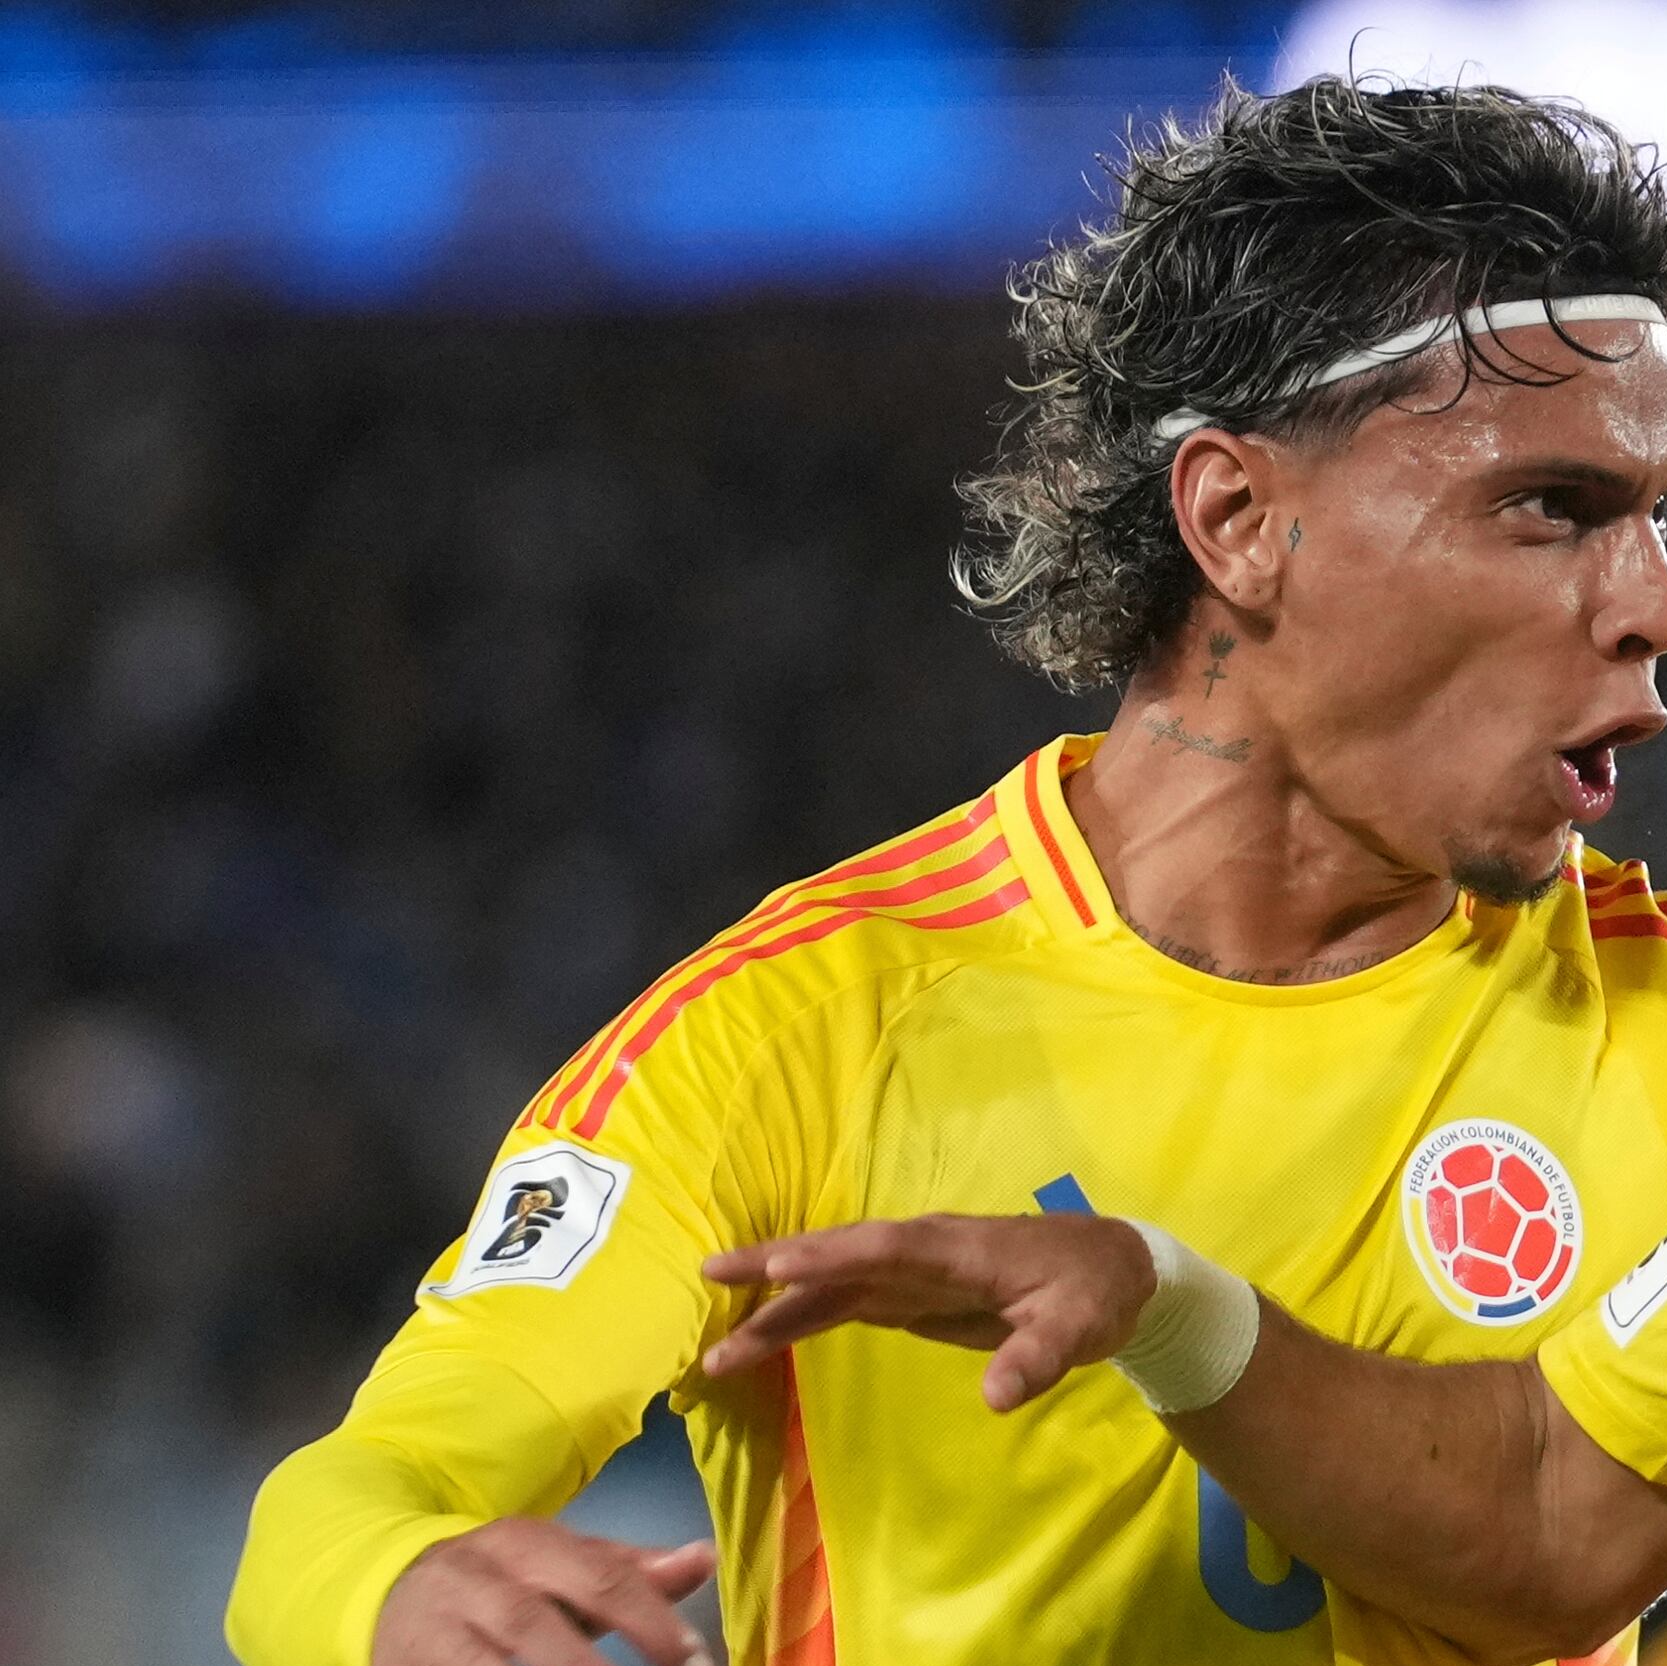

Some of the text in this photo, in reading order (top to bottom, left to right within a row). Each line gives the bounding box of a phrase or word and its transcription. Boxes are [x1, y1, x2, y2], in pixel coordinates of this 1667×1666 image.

[1409, 1125, 1576, 1240] FEDERACION COLOMBIANA DE FUTBOL
